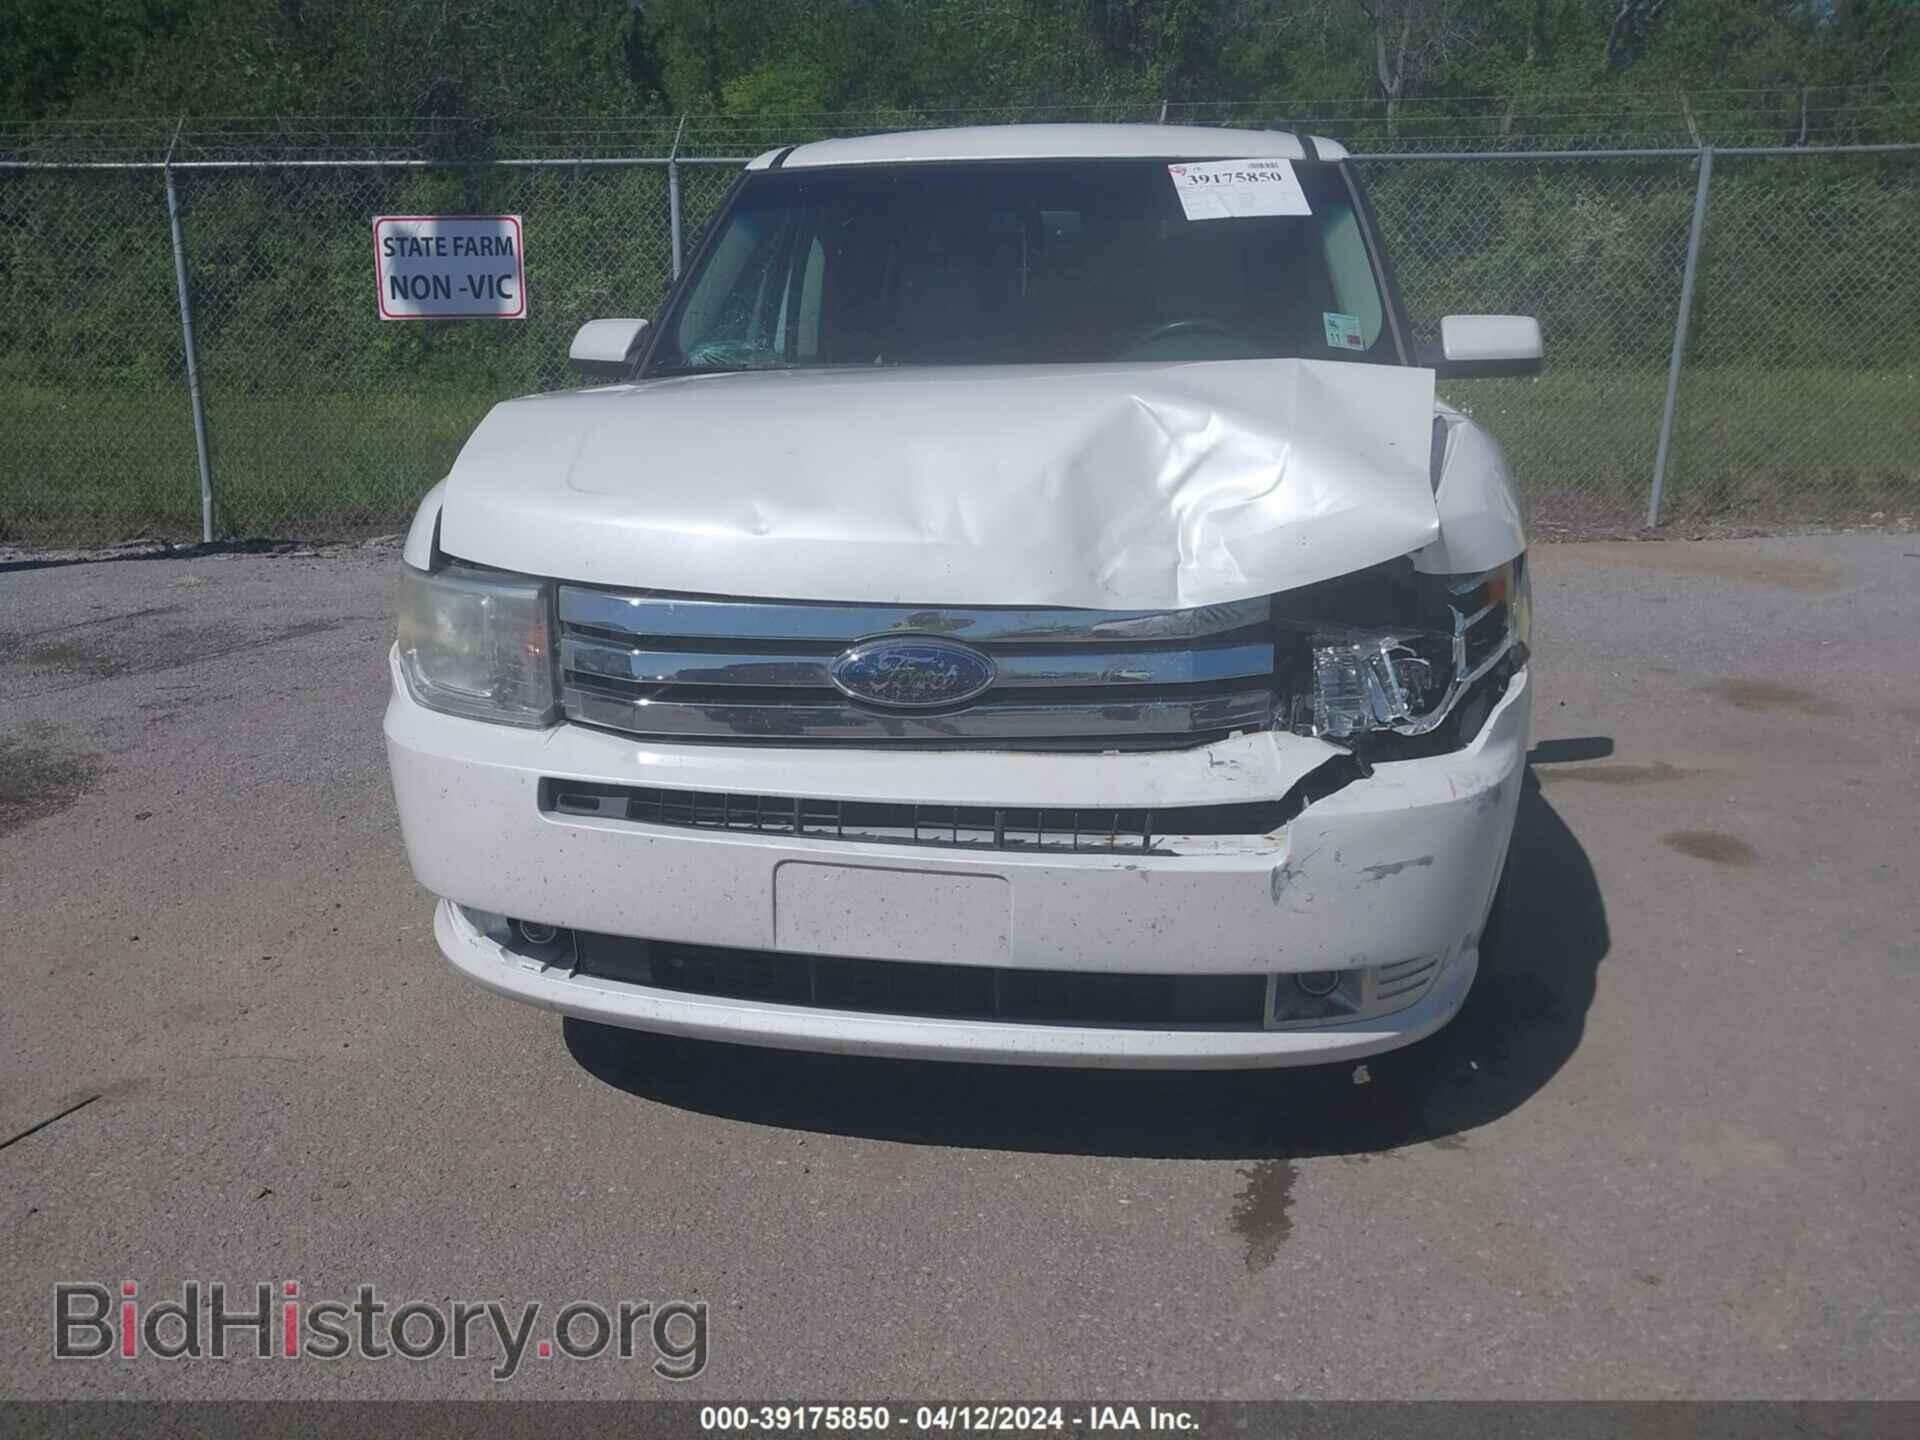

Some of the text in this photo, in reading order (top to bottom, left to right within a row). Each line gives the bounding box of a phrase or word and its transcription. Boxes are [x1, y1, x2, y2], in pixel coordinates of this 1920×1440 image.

[1187, 171, 1282, 186] 39175850
[383, 236, 514, 257] STATE FARM
[390, 274, 452, 300] NON
[868, 652, 961, 690] Ford
